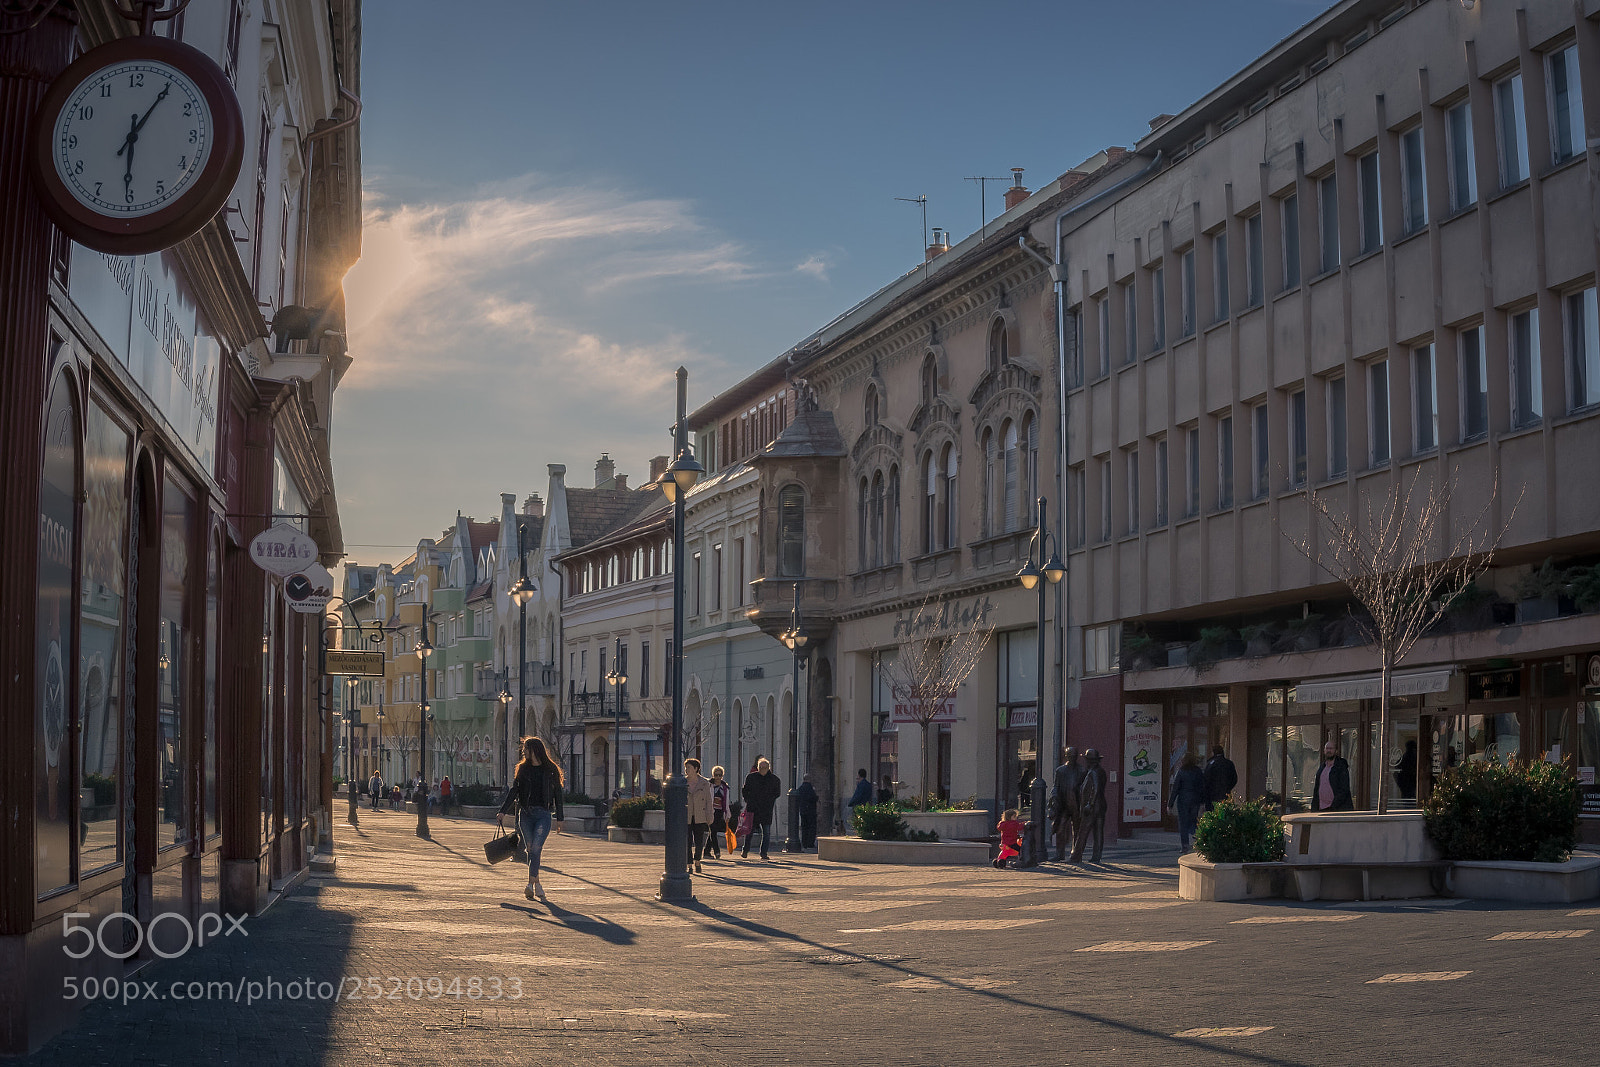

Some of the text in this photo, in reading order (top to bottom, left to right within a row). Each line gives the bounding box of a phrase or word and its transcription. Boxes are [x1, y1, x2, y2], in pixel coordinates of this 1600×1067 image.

[129, 73, 144, 88] 12
[99, 83, 112, 98] 11
[78, 105, 93, 121] 10
[183, 102, 192, 117] 2
[68, 134, 78, 150] 9
[189, 129, 198, 144] 3
[75, 160, 84, 175] 8
[177, 155, 187, 170] 4
[94, 181, 103, 196] 7
[155, 180, 165, 195] 5
[125, 188, 134, 203] 6
[256, 537, 311, 559] VIRÁG
